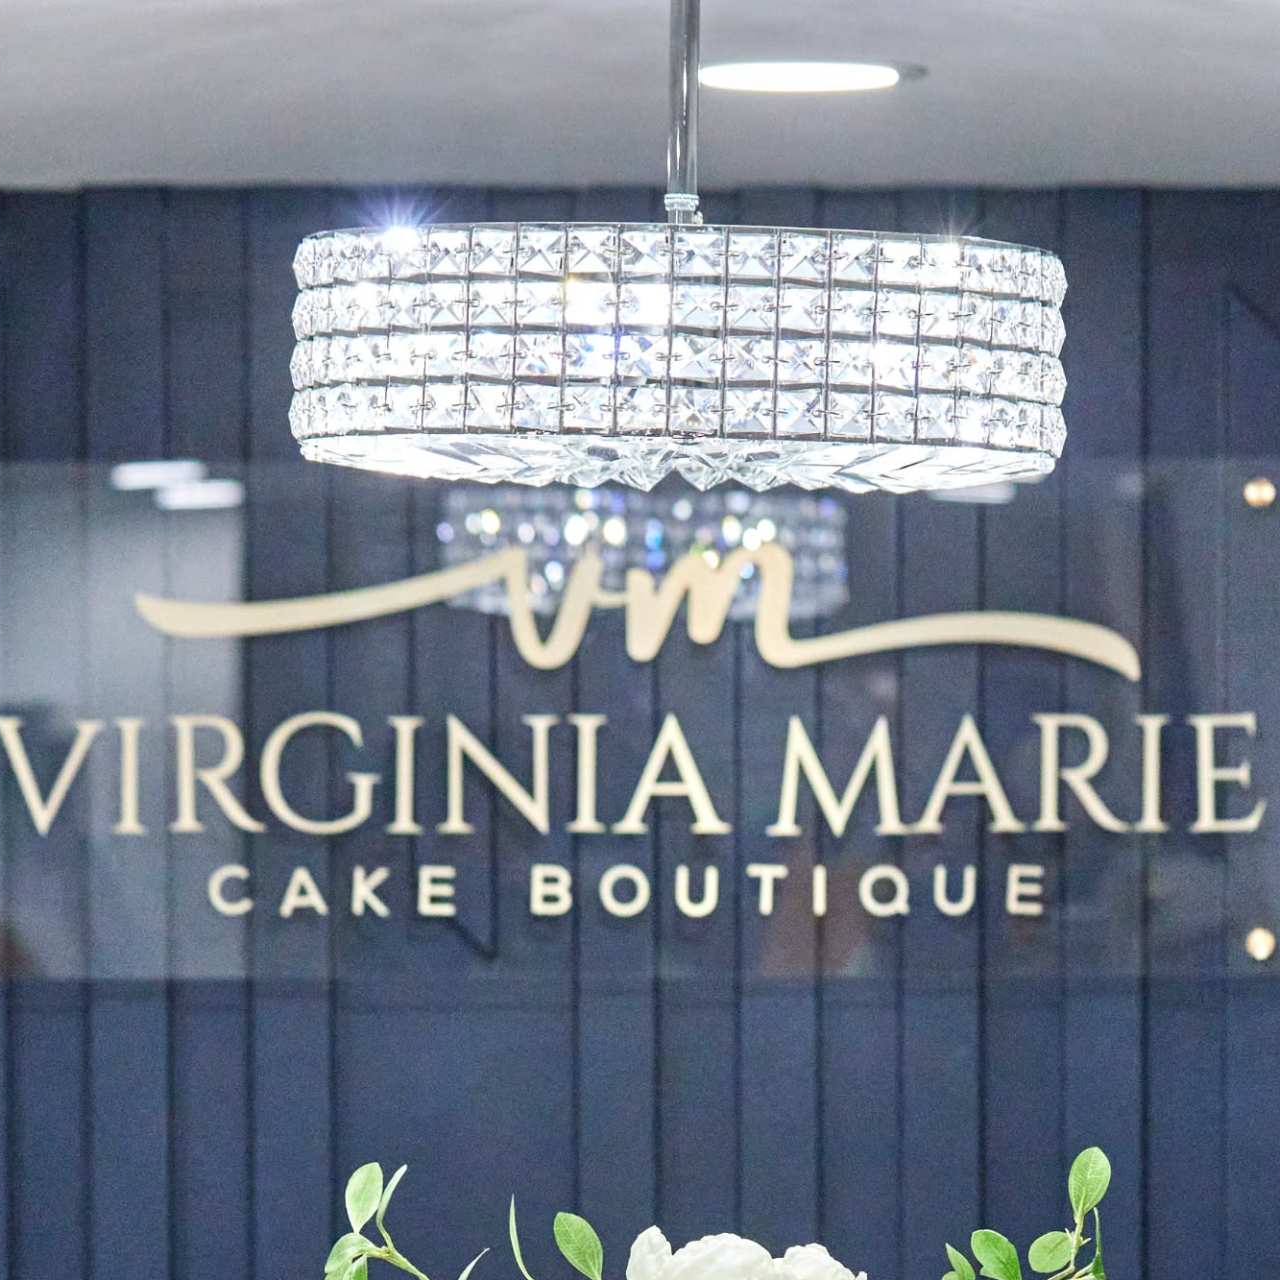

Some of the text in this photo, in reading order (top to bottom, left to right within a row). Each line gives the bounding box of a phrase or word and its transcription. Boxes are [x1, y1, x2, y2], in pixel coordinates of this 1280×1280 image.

[766, 713, 1266, 837] MARIE
[207, 864, 1044, 919] CAKE BOUTIQUE
